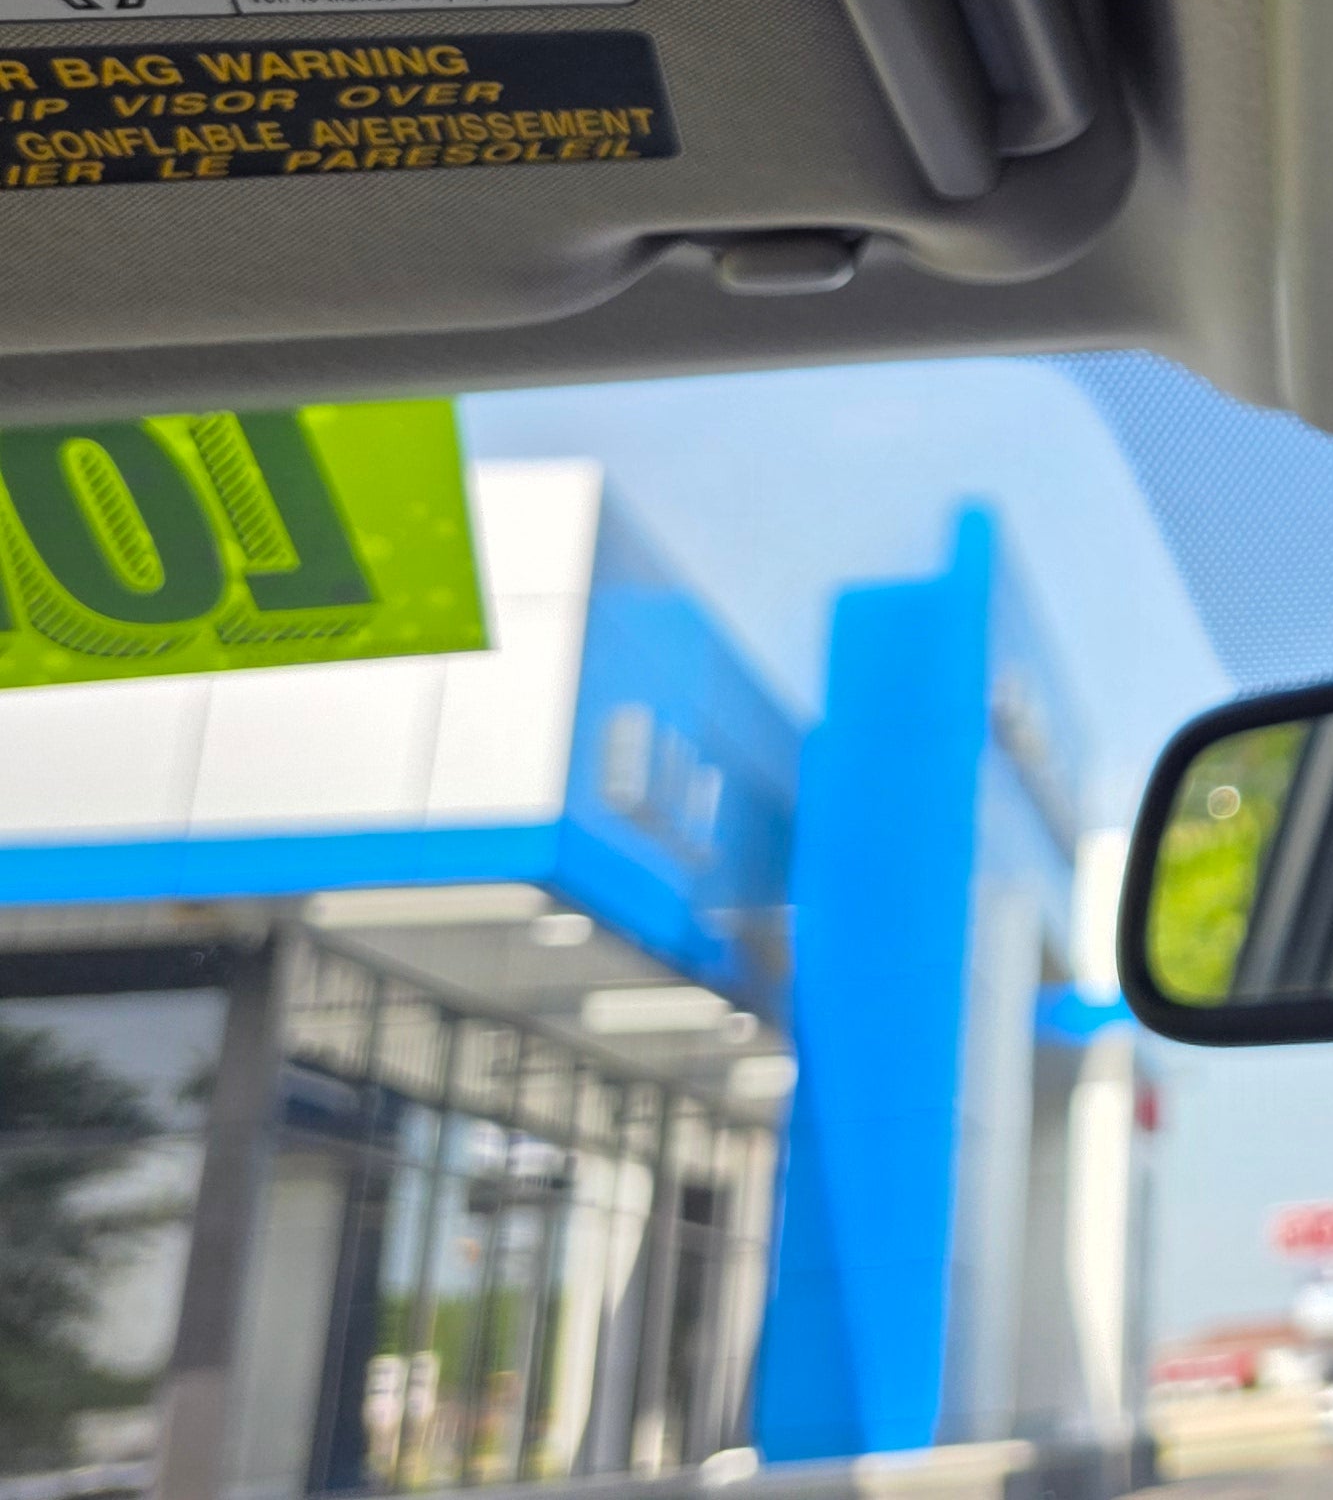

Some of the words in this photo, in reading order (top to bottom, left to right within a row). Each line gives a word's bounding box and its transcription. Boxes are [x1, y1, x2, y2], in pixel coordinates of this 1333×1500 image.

[51, 53, 185, 89] BAG
[197, 45, 470, 84] WARNING
[0, 98, 70, 122] IP
[112, 88, 300, 117] VISOR
[337, 80, 506, 109] OVER
[15, 120, 292, 162] GONFLABLE
[311, 108, 655, 148] AVERTISSEMENT
[158, 153, 235, 180] LE
[283, 137, 643, 173] PARESOLEIL
